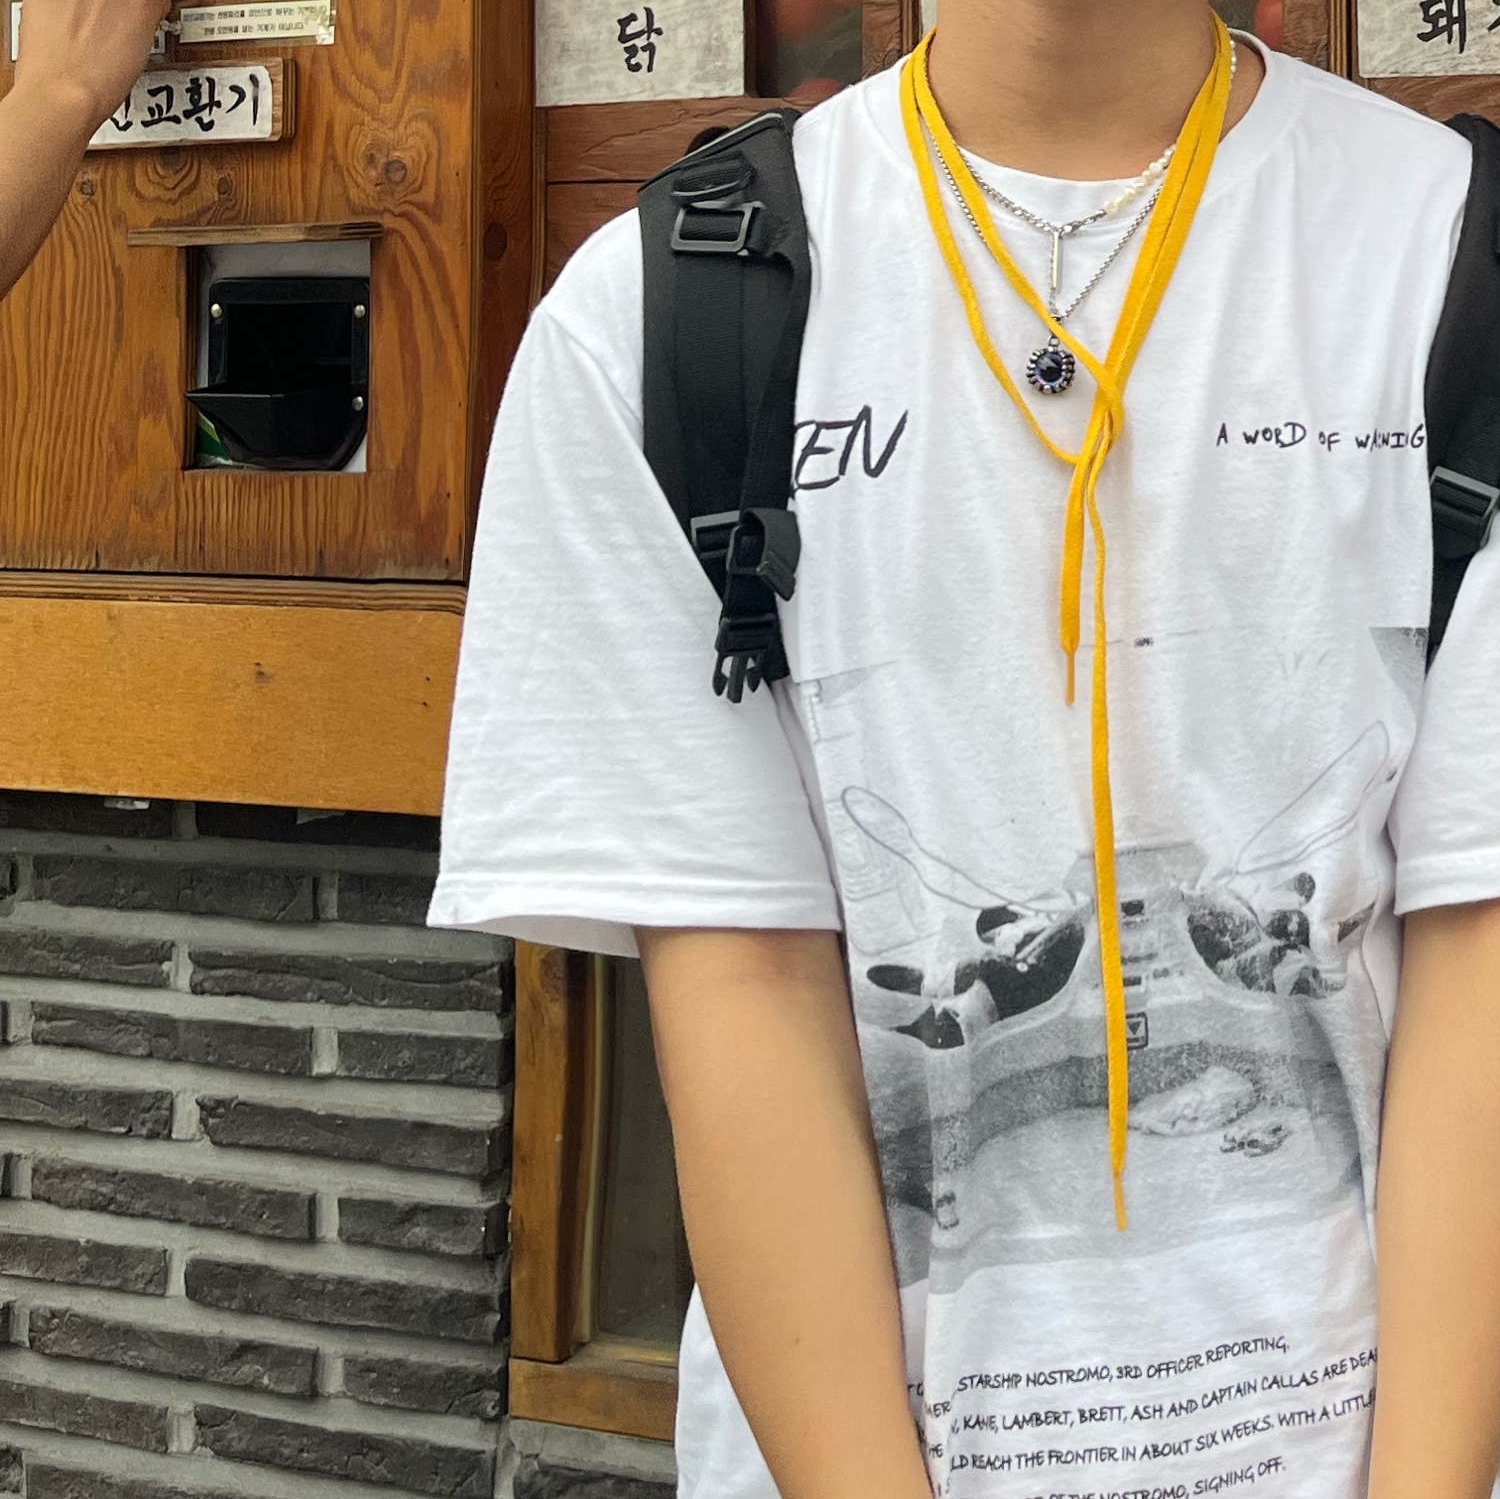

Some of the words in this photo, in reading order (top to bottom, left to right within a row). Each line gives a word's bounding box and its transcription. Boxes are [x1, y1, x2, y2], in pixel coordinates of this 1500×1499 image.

[616, 6, 664, 74] 닭
[793, 404, 909, 492] EN
[1215, 422, 1229, 447] A
[1242, 421, 1307, 449] WORD
[1318, 430, 1341, 451] OF
[957, 1372, 1023, 1392] STARSHIP
[1026, 1364, 1114, 1388] NOSTROMO,
[1116, 1364, 1143, 1380] 3RD
[1146, 1354, 1205, 1380] OFFICER
[1205, 1335, 1291, 1363] REPORTING.
[1002, 1410, 1075, 1430] LAMBERT,
[1078, 1404, 1128, 1423] BRETT,
[1130, 1403, 1164, 1421] ASH
[1166, 1398, 1199, 1419] AND
[1201, 1379, 1258, 1410] CAPTAIN
[1322, 1358, 1348, 1382] ARE
[971, 1453, 1013, 1471] REACH
[1015, 1450, 1044, 1469] THE
[1047, 1444, 1118, 1466] FRONTIER
[1121, 1444, 1137, 1462] IN
[1138, 1438, 1193, 1461] ABOUT
[1194, 1430, 1220, 1452] SIX
[1220, 1414, 1276, 1442] WEEKS.
[1277, 1408, 1317, 1428] WITH
[1318, 1405, 1331, 1422] A
[1192, 1463, 1255, 1496] SIGNING
[1256, 1456, 1287, 1478] OFF.
